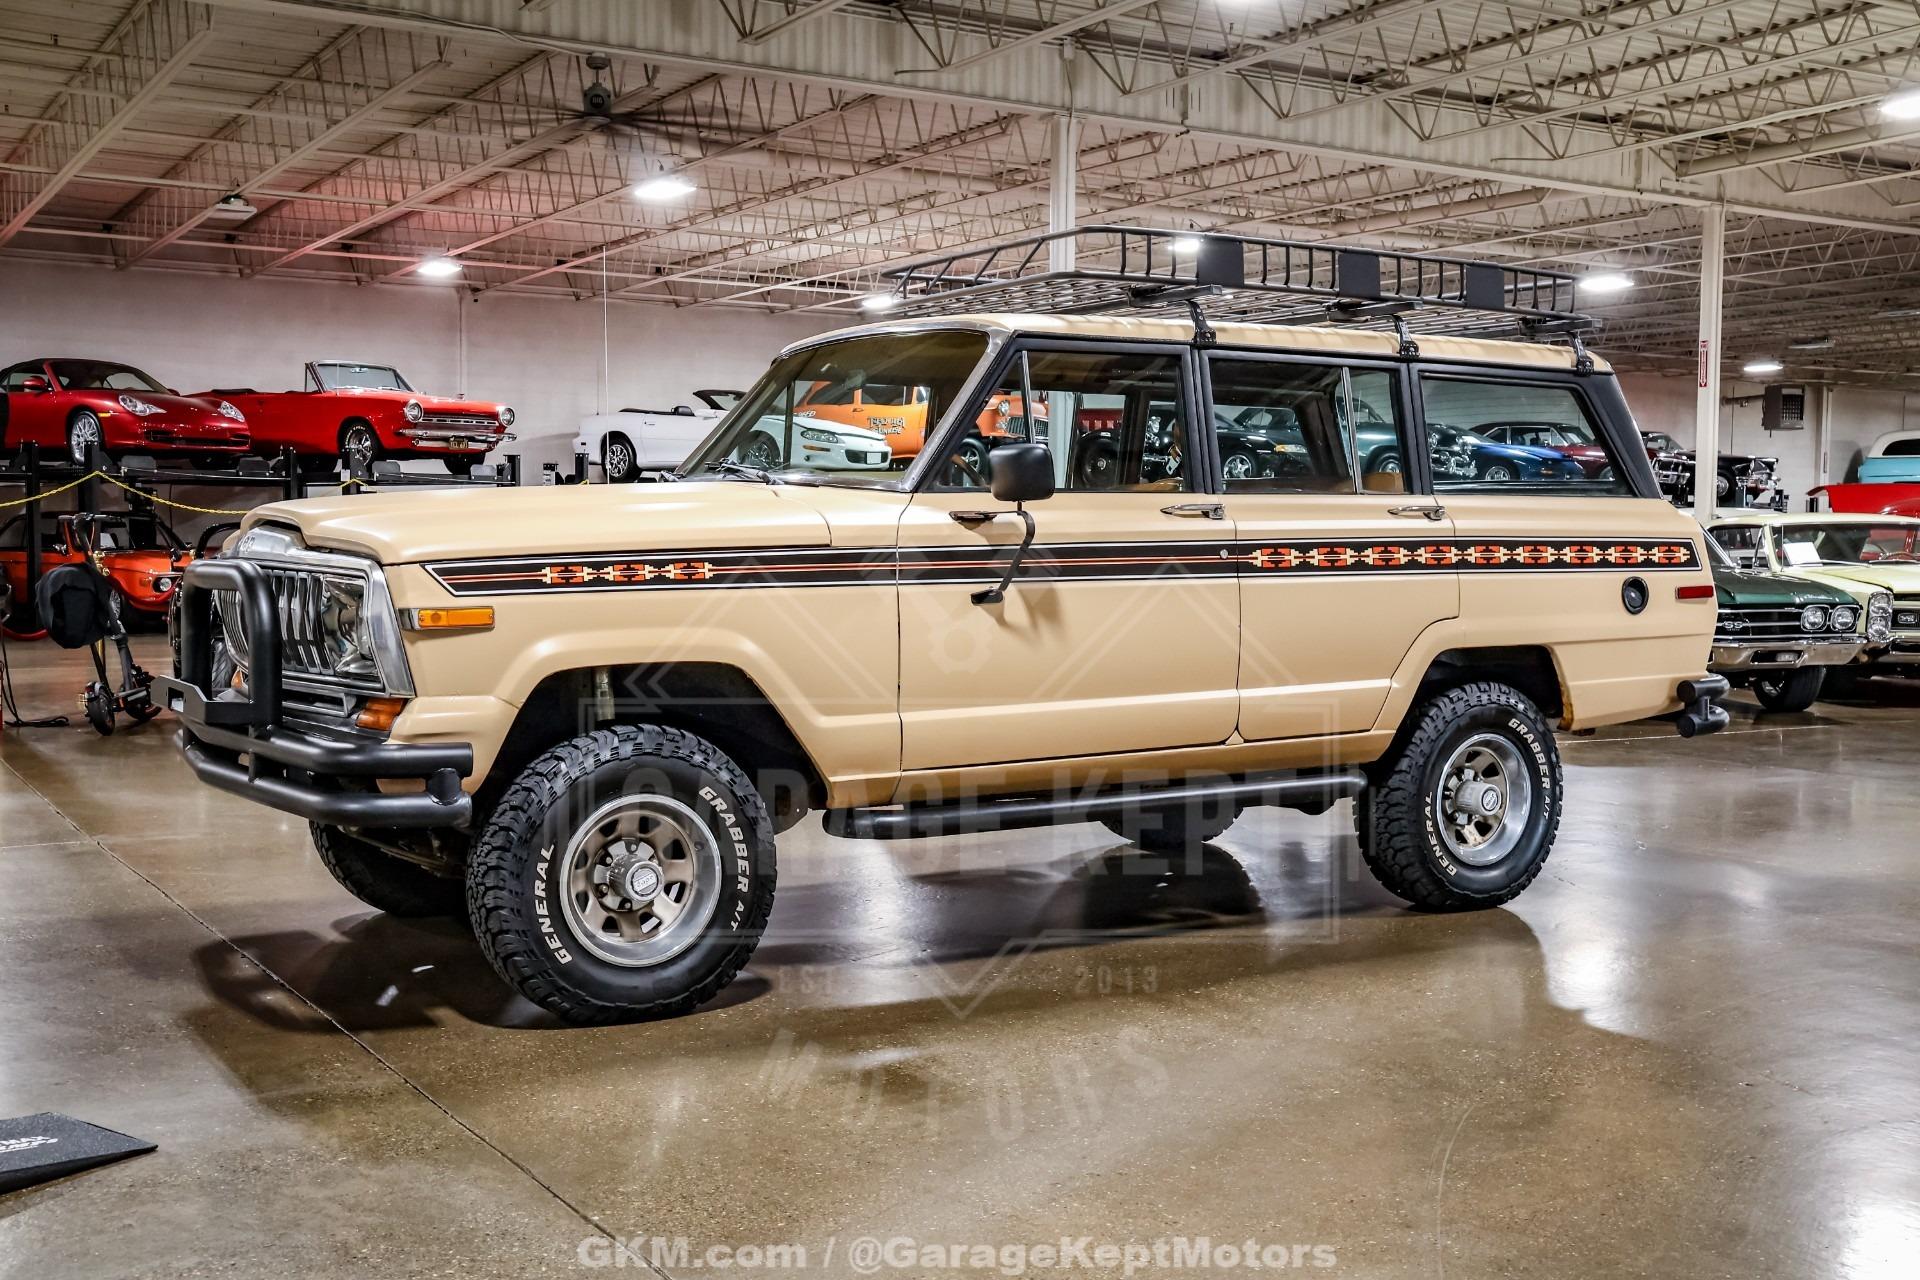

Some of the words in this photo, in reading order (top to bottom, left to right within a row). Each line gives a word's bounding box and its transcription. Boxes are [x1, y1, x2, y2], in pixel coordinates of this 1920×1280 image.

[1509, 719, 1551, 789] GRABBER
[699, 786, 750, 893] GRABBER
[729, 900, 744, 931] A/T
[1424, 792, 1457, 877] GENERAL
[534, 844, 572, 964] GENERAL
